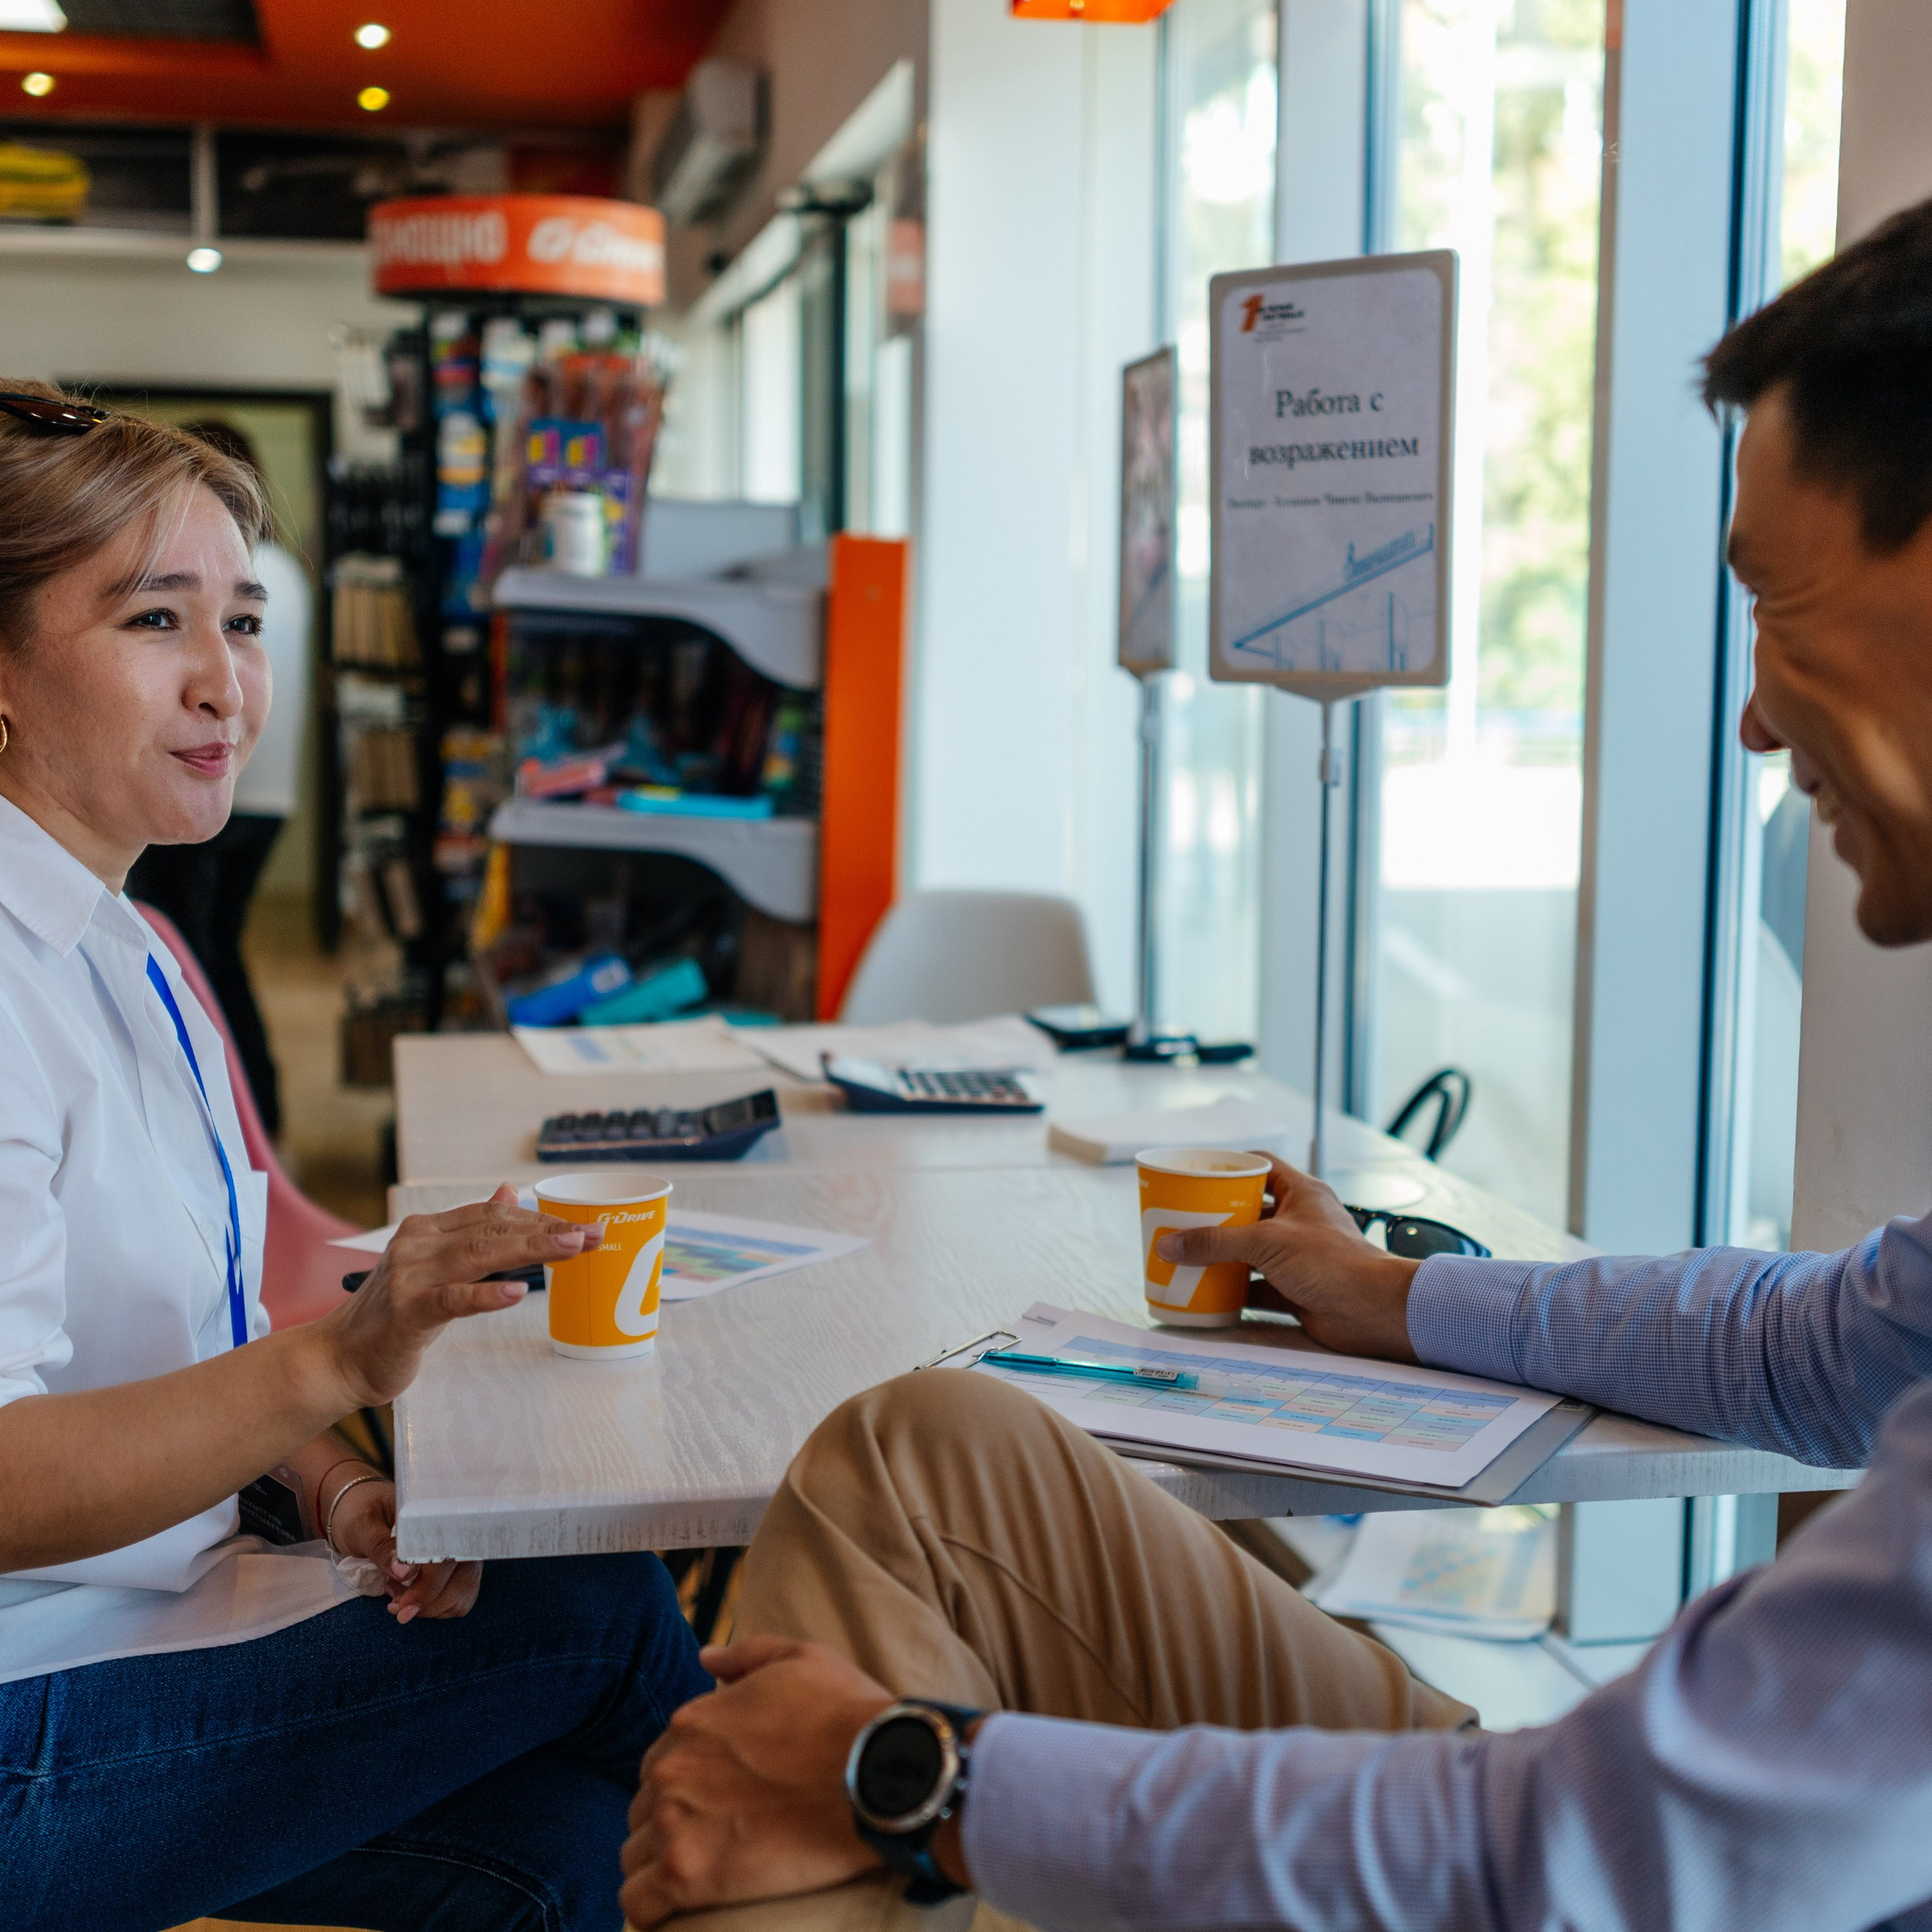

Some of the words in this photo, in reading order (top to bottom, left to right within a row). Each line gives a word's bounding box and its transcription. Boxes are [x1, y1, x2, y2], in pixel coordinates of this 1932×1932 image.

[1275, 388, 1361, 418] Работа
[1369, 392, 1384, 411] с
[1249, 437, 1419, 469] возражением
[598, 1242, 623, 1252] SMALL
